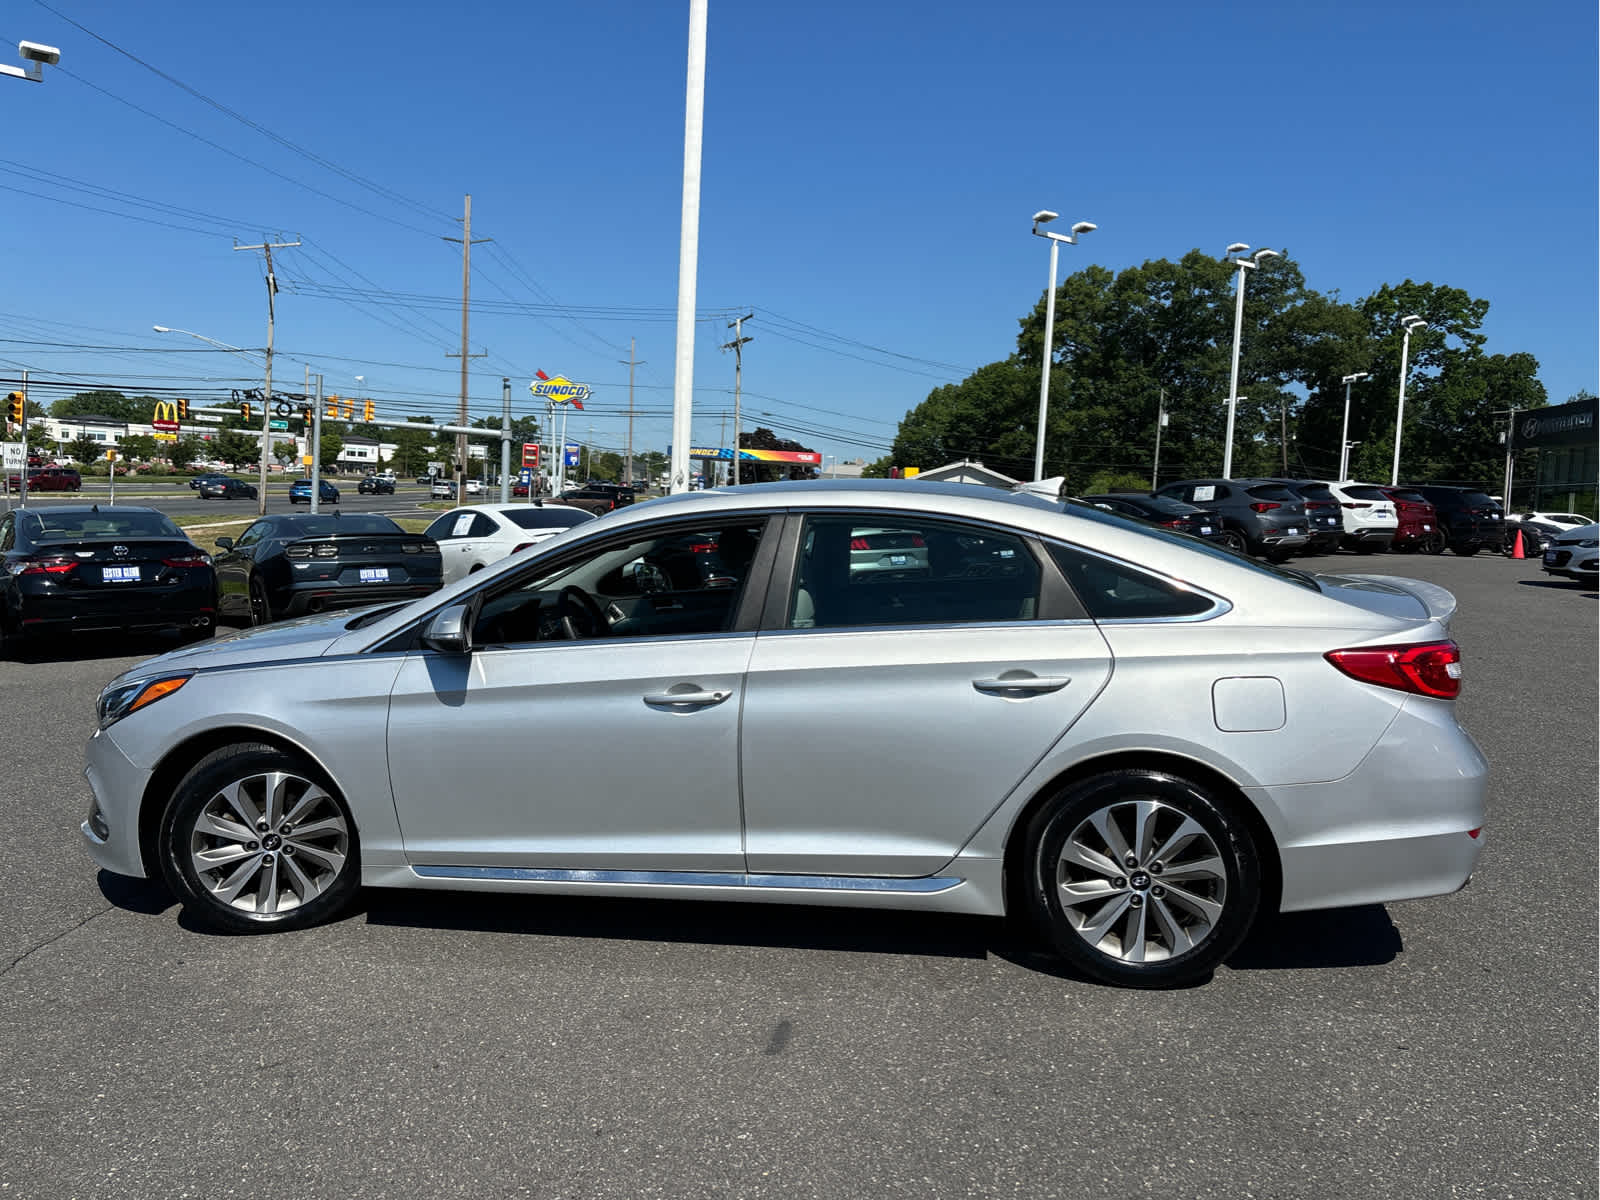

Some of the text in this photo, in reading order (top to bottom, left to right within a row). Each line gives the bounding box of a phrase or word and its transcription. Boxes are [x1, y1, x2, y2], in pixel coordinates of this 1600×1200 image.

[534, 384, 584, 396] SUNOCO
[10, 447, 21, 456] NO
[689, 448, 719, 456] UNOCO
[5, 457, 26, 465] TURNS
